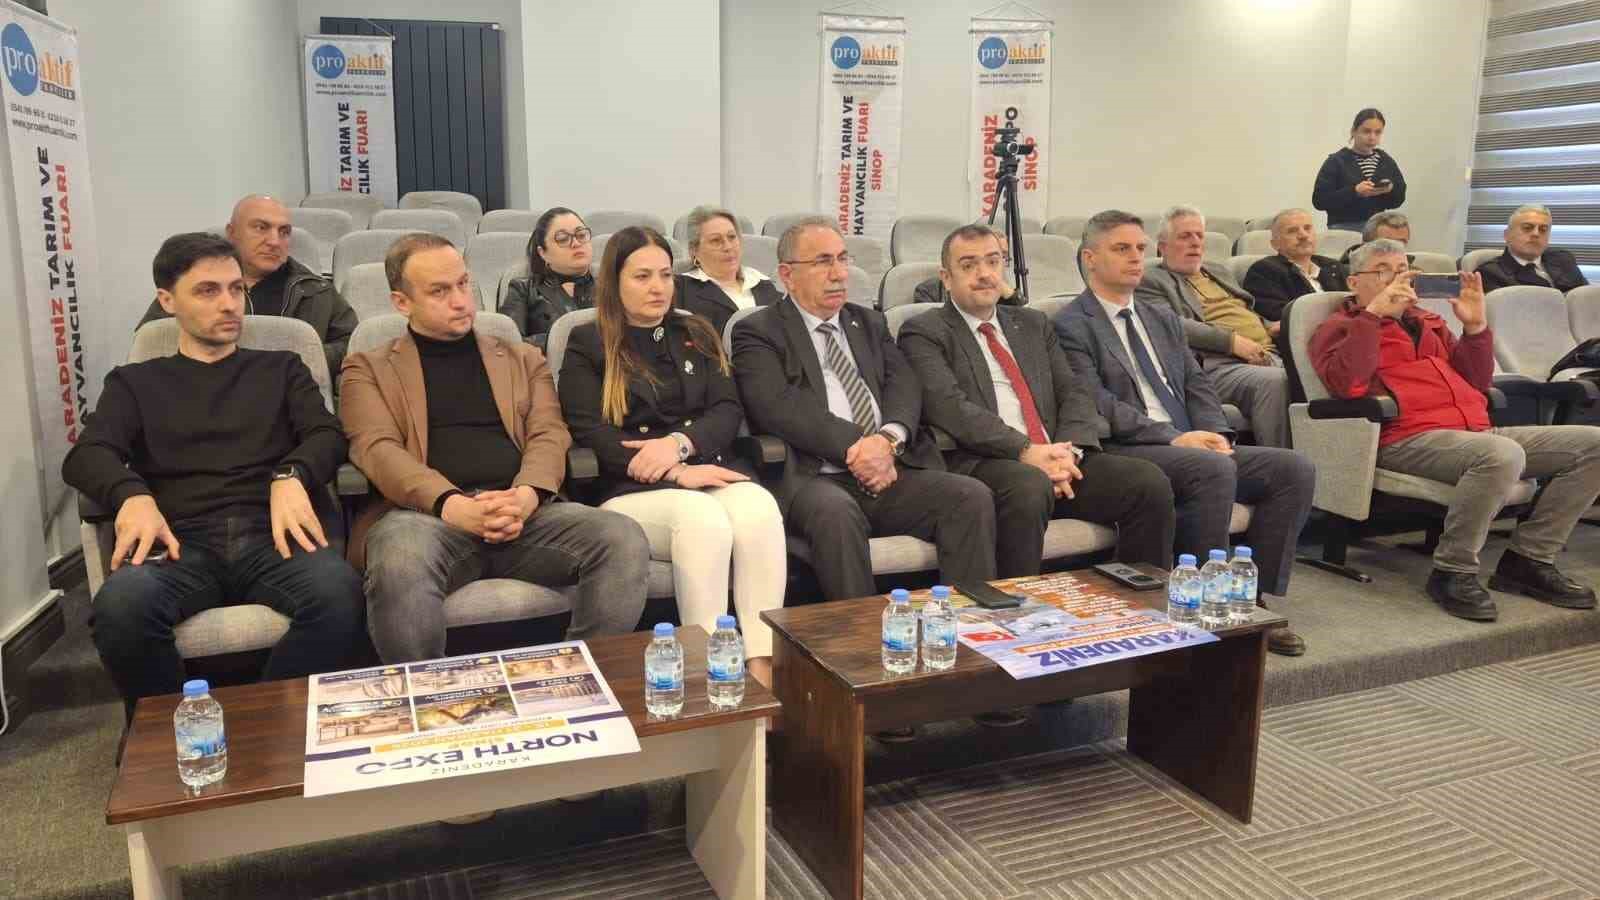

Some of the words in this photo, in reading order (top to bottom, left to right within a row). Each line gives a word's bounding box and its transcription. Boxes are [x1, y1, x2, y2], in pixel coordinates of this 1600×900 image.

[4, 45, 36, 77] pro
[316, 55, 343, 73] pro
[834, 47, 860, 62] pro
[981, 47, 1006, 62] pro
[338, 102, 350, 122] VE
[843, 96, 854, 114] VE
[858, 102, 869, 143] FUARI
[339, 126, 352, 174] TARIM
[356, 110, 369, 155] FUARI
[841, 117, 853, 160] TARIM
[37, 146, 49, 186] VE
[869, 149, 882, 191] SİNOP
[55, 164, 73, 251] FUARI
[838, 162, 851, 235] ARADENİZ
[854, 146, 867, 235] HAYVANCILIK
[42, 197, 60, 290] TARIM
[65, 260, 88, 426] AYVANCILIK
[51, 298, 78, 444] ARADENİZ
[355, 749, 465, 775] EXPO
[474, 729, 598, 759] NORTH
